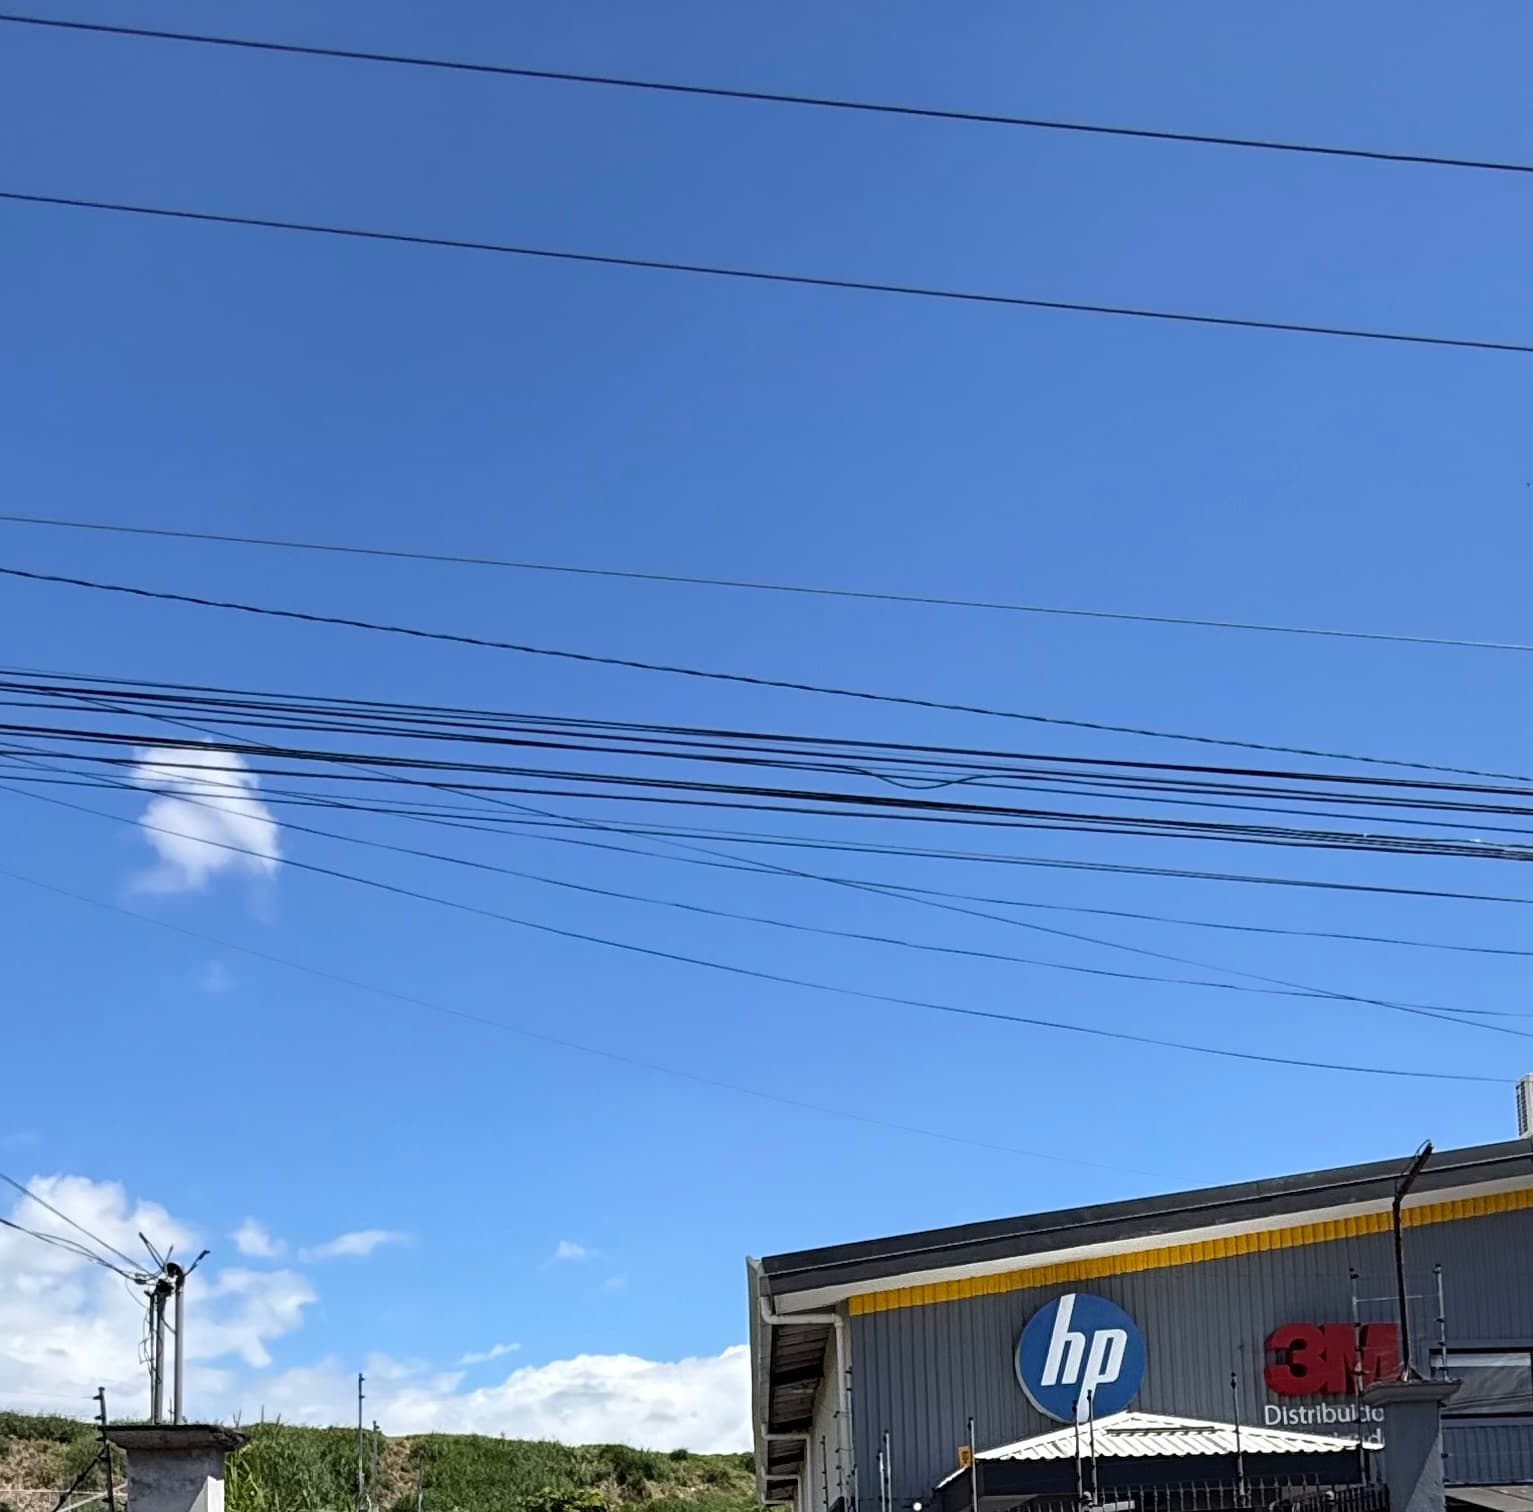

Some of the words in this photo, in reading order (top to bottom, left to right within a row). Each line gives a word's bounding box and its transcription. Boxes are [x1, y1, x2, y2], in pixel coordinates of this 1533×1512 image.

[1041, 1293, 1127, 1423] hp
[1264, 1321, 1399, 1397] 3M
[1264, 1403, 1385, 1425] Distribuido
